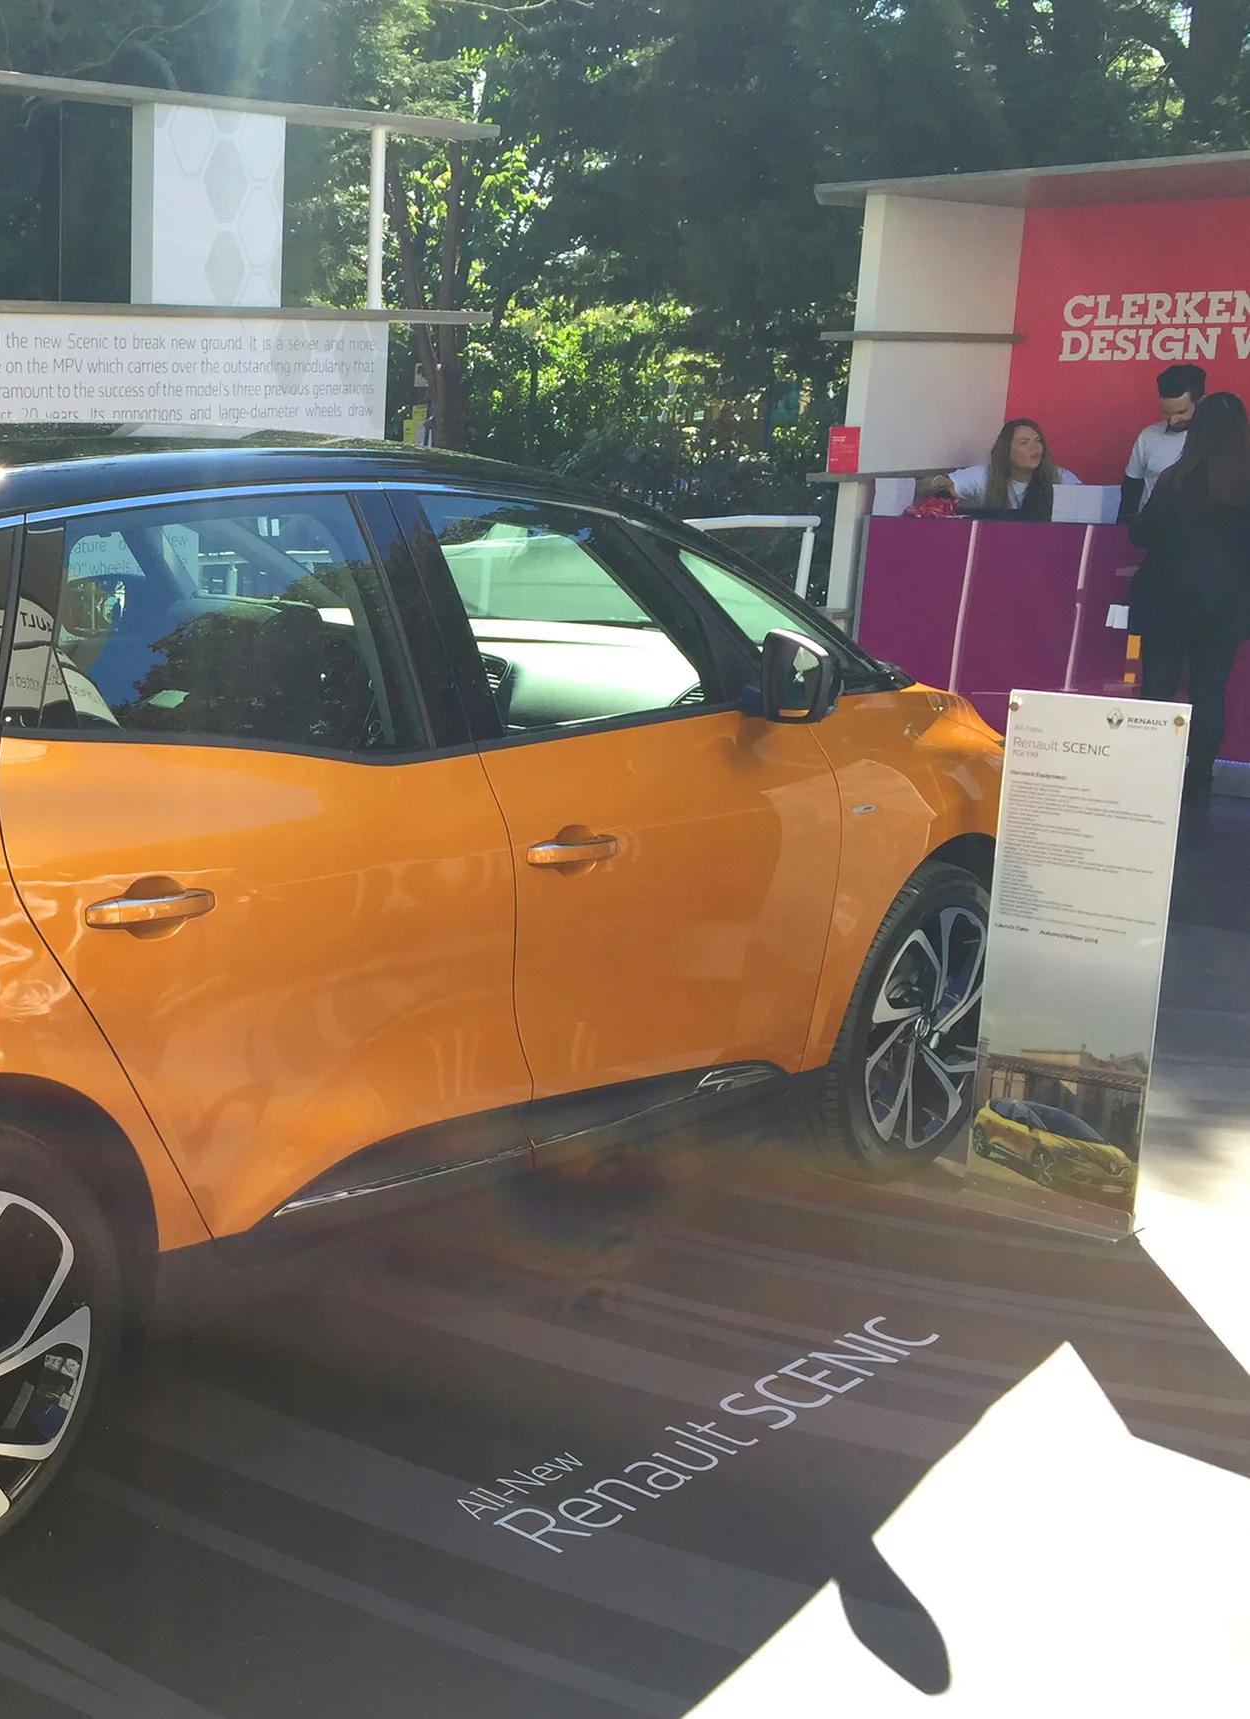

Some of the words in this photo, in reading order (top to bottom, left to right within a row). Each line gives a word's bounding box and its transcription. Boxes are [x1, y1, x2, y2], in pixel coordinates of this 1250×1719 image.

[6, 333, 28, 349] the
[35, 336, 61, 349] new
[68, 333, 108, 349] Scenic
[114, 335, 127, 349] to
[133, 335, 165, 349] break
[171, 337, 196, 349] new
[250, 336, 257, 350] It
[263, 337, 271, 350] is
[277, 339, 283, 350] a
[288, 337, 319, 350] sexier
[324, 338, 344, 351] and
[350, 339, 376, 351] more
[1059, 327, 1221, 361] DESIGN
[6, 361, 22, 374] on
[27, 359, 48, 374] the
[53, 359, 83, 373] MPV
[88, 358, 123, 374] which
[128, 359, 168, 373] carries
[171, 362, 197, 373] over
[201, 359, 220, 373] the
[223, 359, 290, 376] outstanding
[294, 359, 350, 376] modularity
[353, 359, 375, 373] that
[57, 384, 70, 398] to
[74, 383, 94, 398] the
[99, 385, 145, 398] success
[148, 382, 161, 397] of
[163, 383, 182, 397] the
[186, 382, 229, 397] model's
[232, 382, 261, 397] three
[264, 383, 310, 398] previous
[312, 383, 374, 399] generations
[90, 408, 104, 419] Its
[190, 405, 211, 420] and
[219, 404, 299, 423] large-diameter
[305, 403, 342, 417] wheels
[348, 404, 373, 417] draw
[1127, 717, 1168, 727] RENAULT
[1013, 737, 1058, 752] Renault
[1062, 741, 1111, 756] SCENIC
[493, 1421, 759, 1553] Renault
[719, 1316, 940, 1430] SCENIC
[457, 1452, 583, 1520] All-New
